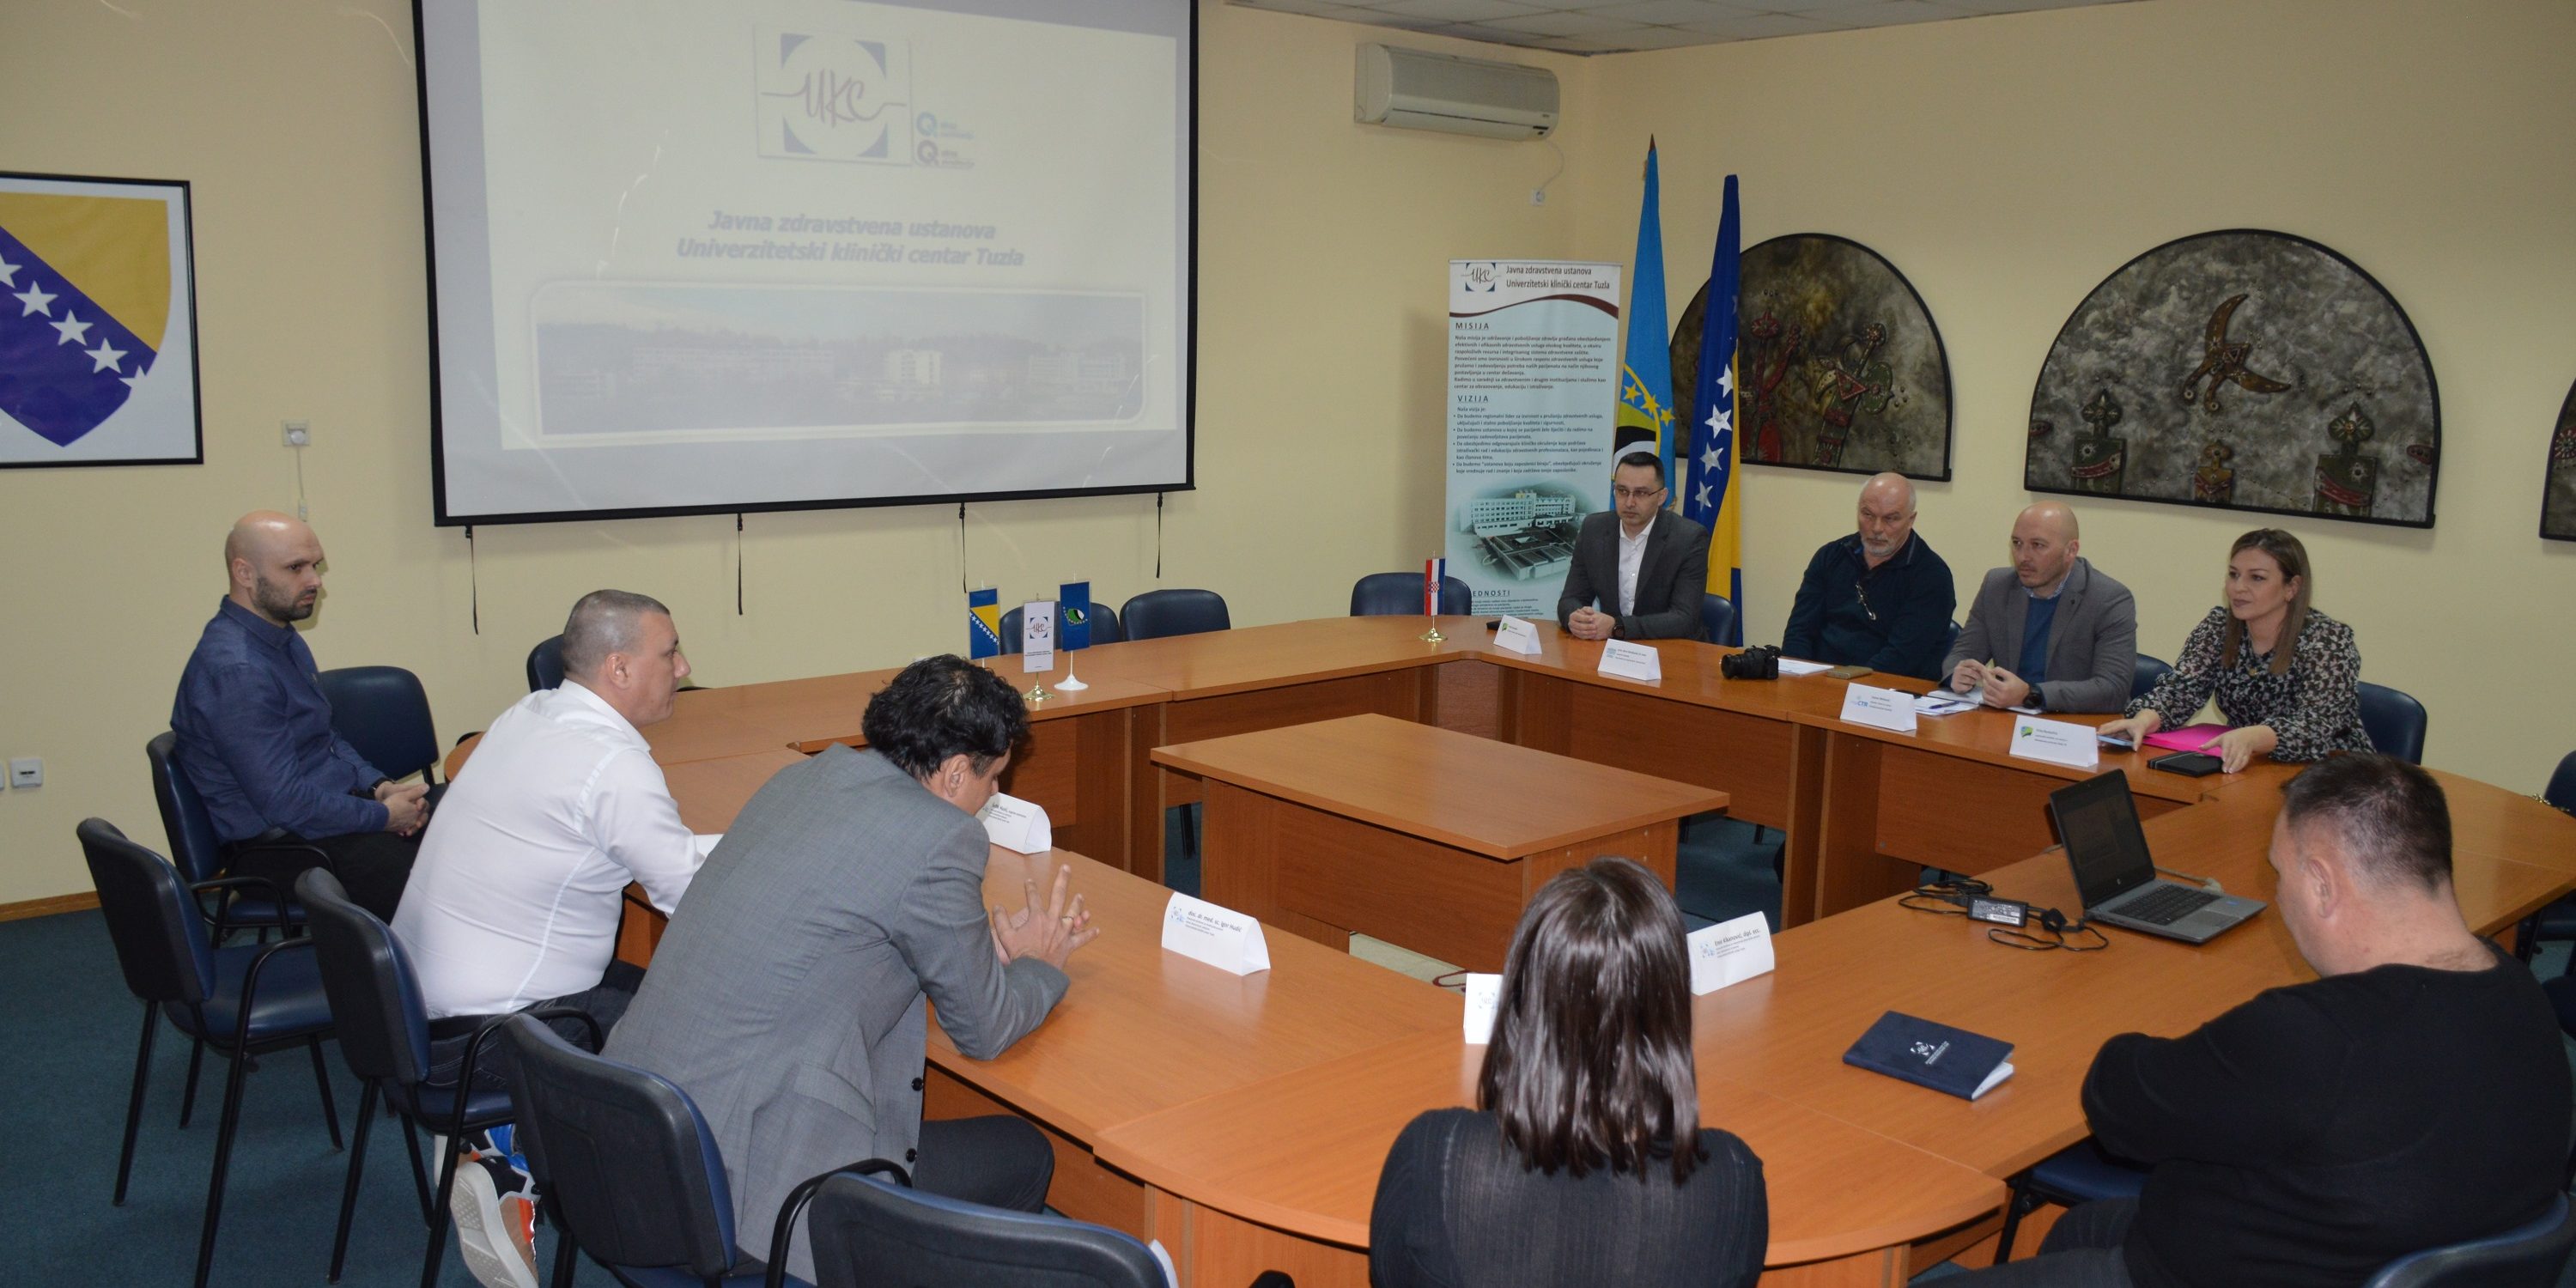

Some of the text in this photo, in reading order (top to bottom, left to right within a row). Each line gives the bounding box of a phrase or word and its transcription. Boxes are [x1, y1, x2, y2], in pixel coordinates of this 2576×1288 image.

[708, 209, 996, 240] Javna zdravstvena ustanova
[676, 236, 1025, 267] Univerzitetski klinički centar Tuzla
[1506, 265, 1592, 275] Javna zdravstvena ustanova
[1506, 279, 1610, 289] Univerzitetski klinički centar Tuzla
